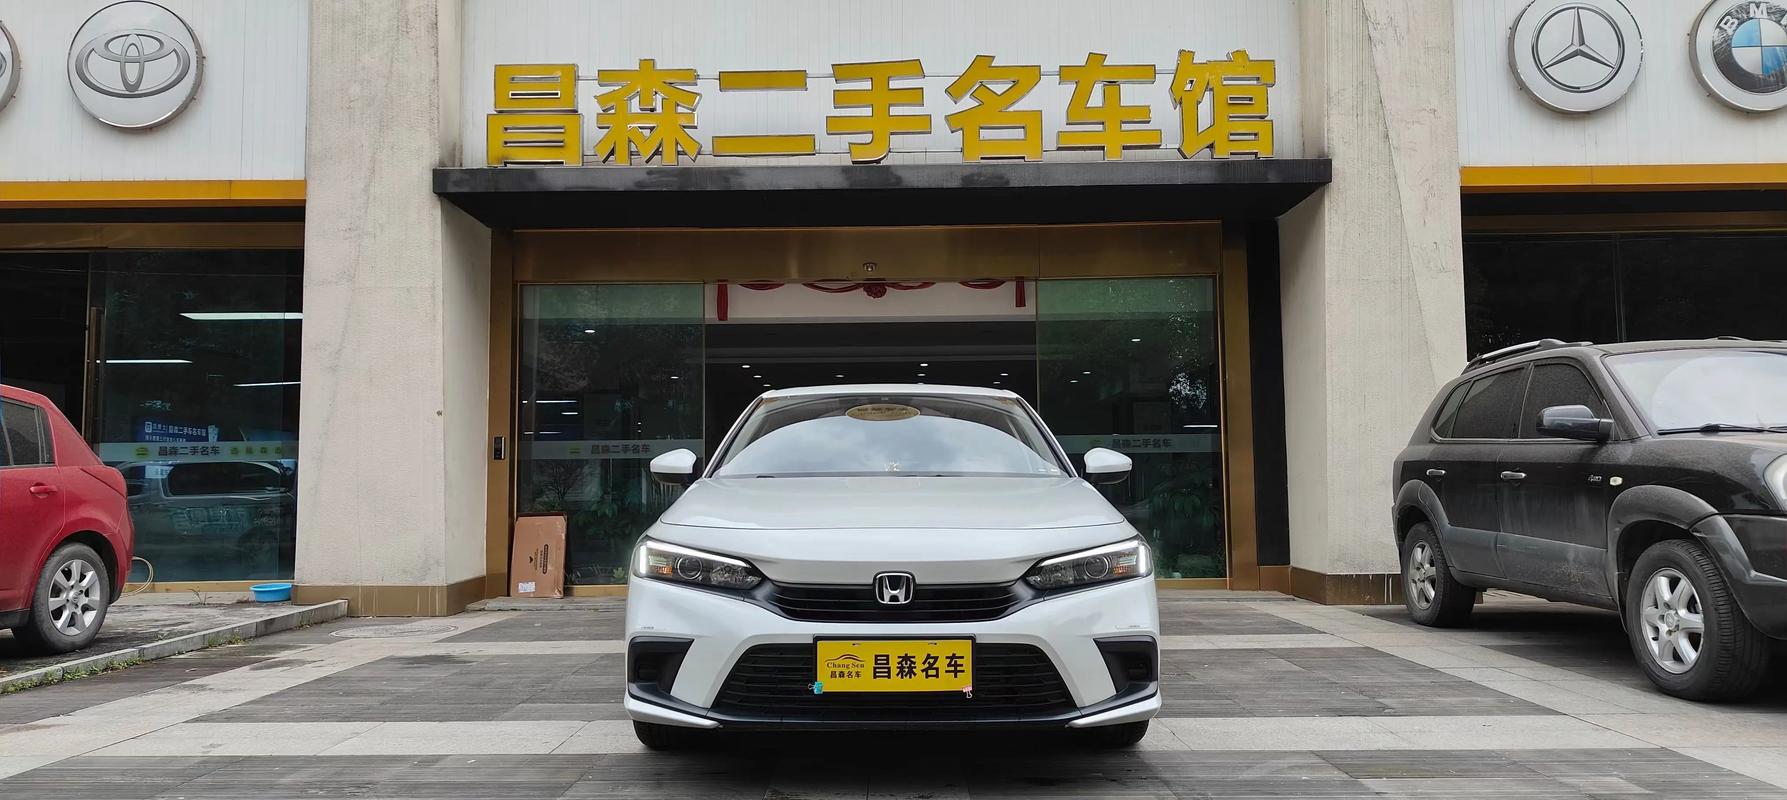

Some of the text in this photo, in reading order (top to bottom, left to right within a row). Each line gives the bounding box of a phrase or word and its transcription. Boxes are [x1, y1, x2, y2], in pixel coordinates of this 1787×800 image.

[486, 49, 1276, 167] 昌森二手名车馆
[158, 446, 220, 456] 昌森二手名车
[826, 661, 850, 669] Chang
[872, 653, 966, 680] 昌森名车
[830, 670, 862, 679] 昌森名车
